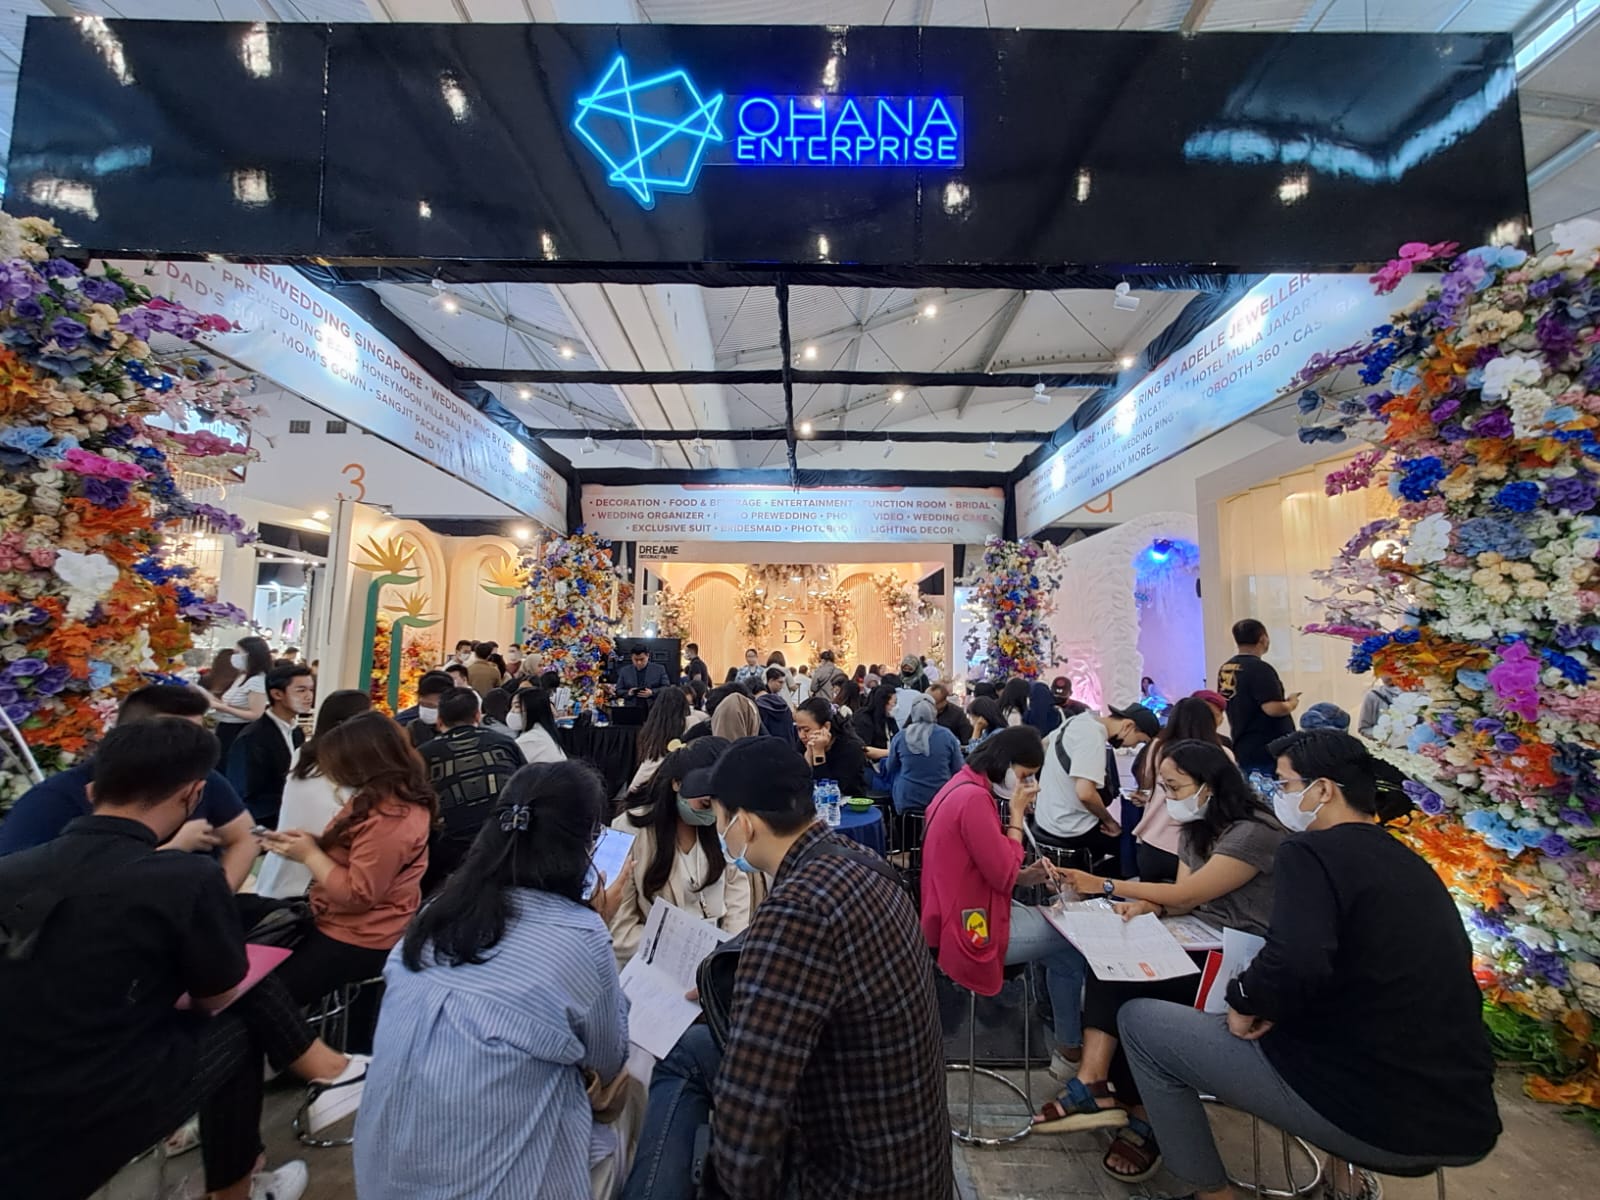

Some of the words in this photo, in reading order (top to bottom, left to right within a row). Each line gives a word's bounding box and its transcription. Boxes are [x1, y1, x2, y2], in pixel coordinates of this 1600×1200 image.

[738, 96, 958, 138] OHANA
[736, 137, 957, 161] ENTERPRISE
[165, 261, 226, 307] DAD'S
[244, 263, 351, 340] REWEDDING
[354, 330, 423, 390] SINGAPORE
[430, 384, 472, 424] WEDDING
[1138, 381, 1162, 406] RING
[1163, 369, 1179, 388] BY
[1179, 330, 1226, 376] ADELLE
[1228, 272, 1314, 340] JEWELLER
[1256, 343, 1280, 368] 360
[281, 332, 329, 369] MOM'S
[331, 362, 367, 391] GOWN
[375, 389, 414, 420] SANGJIT
[1192, 357, 1224, 387] HOTEL
[1226, 331, 1263, 364] MULIA
[362, 361, 422, 407] HONEYMOON
[423, 401, 444, 424] VILLA
[414, 430, 435, 450] AND
[1121, 427, 1154, 454] WEDDING
[1154, 414, 1175, 433] RING
[1090, 473, 1106, 490] AND
[1106, 459, 1128, 481] MANY
[595, 498, 661, 508] DECORATION
[669, 498, 698, 508] FOOD
[700, 499, 707, 508] &
[771, 499, 853, 509] ENTERTAINMENT
[916, 500, 947, 509] ROOM
[955, 501, 991, 510] BRIDAL
[597, 511, 645, 520] WEDDING
[647, 511, 704, 520] ORGANIZER
[751, 511, 817, 521] PREWEDDING
[873, 513, 904, 521] VIDEO
[912, 513, 960, 522] WEDDING
[962, 514, 988, 522] CAKE
[632, 524, 687, 533] EXCLUSIVE
[689, 524, 712, 533] SUIT
[870, 526, 917, 535] LIGHTING
[919, 527, 954, 535] DECOR
[638, 545, 680, 555] DREAME
